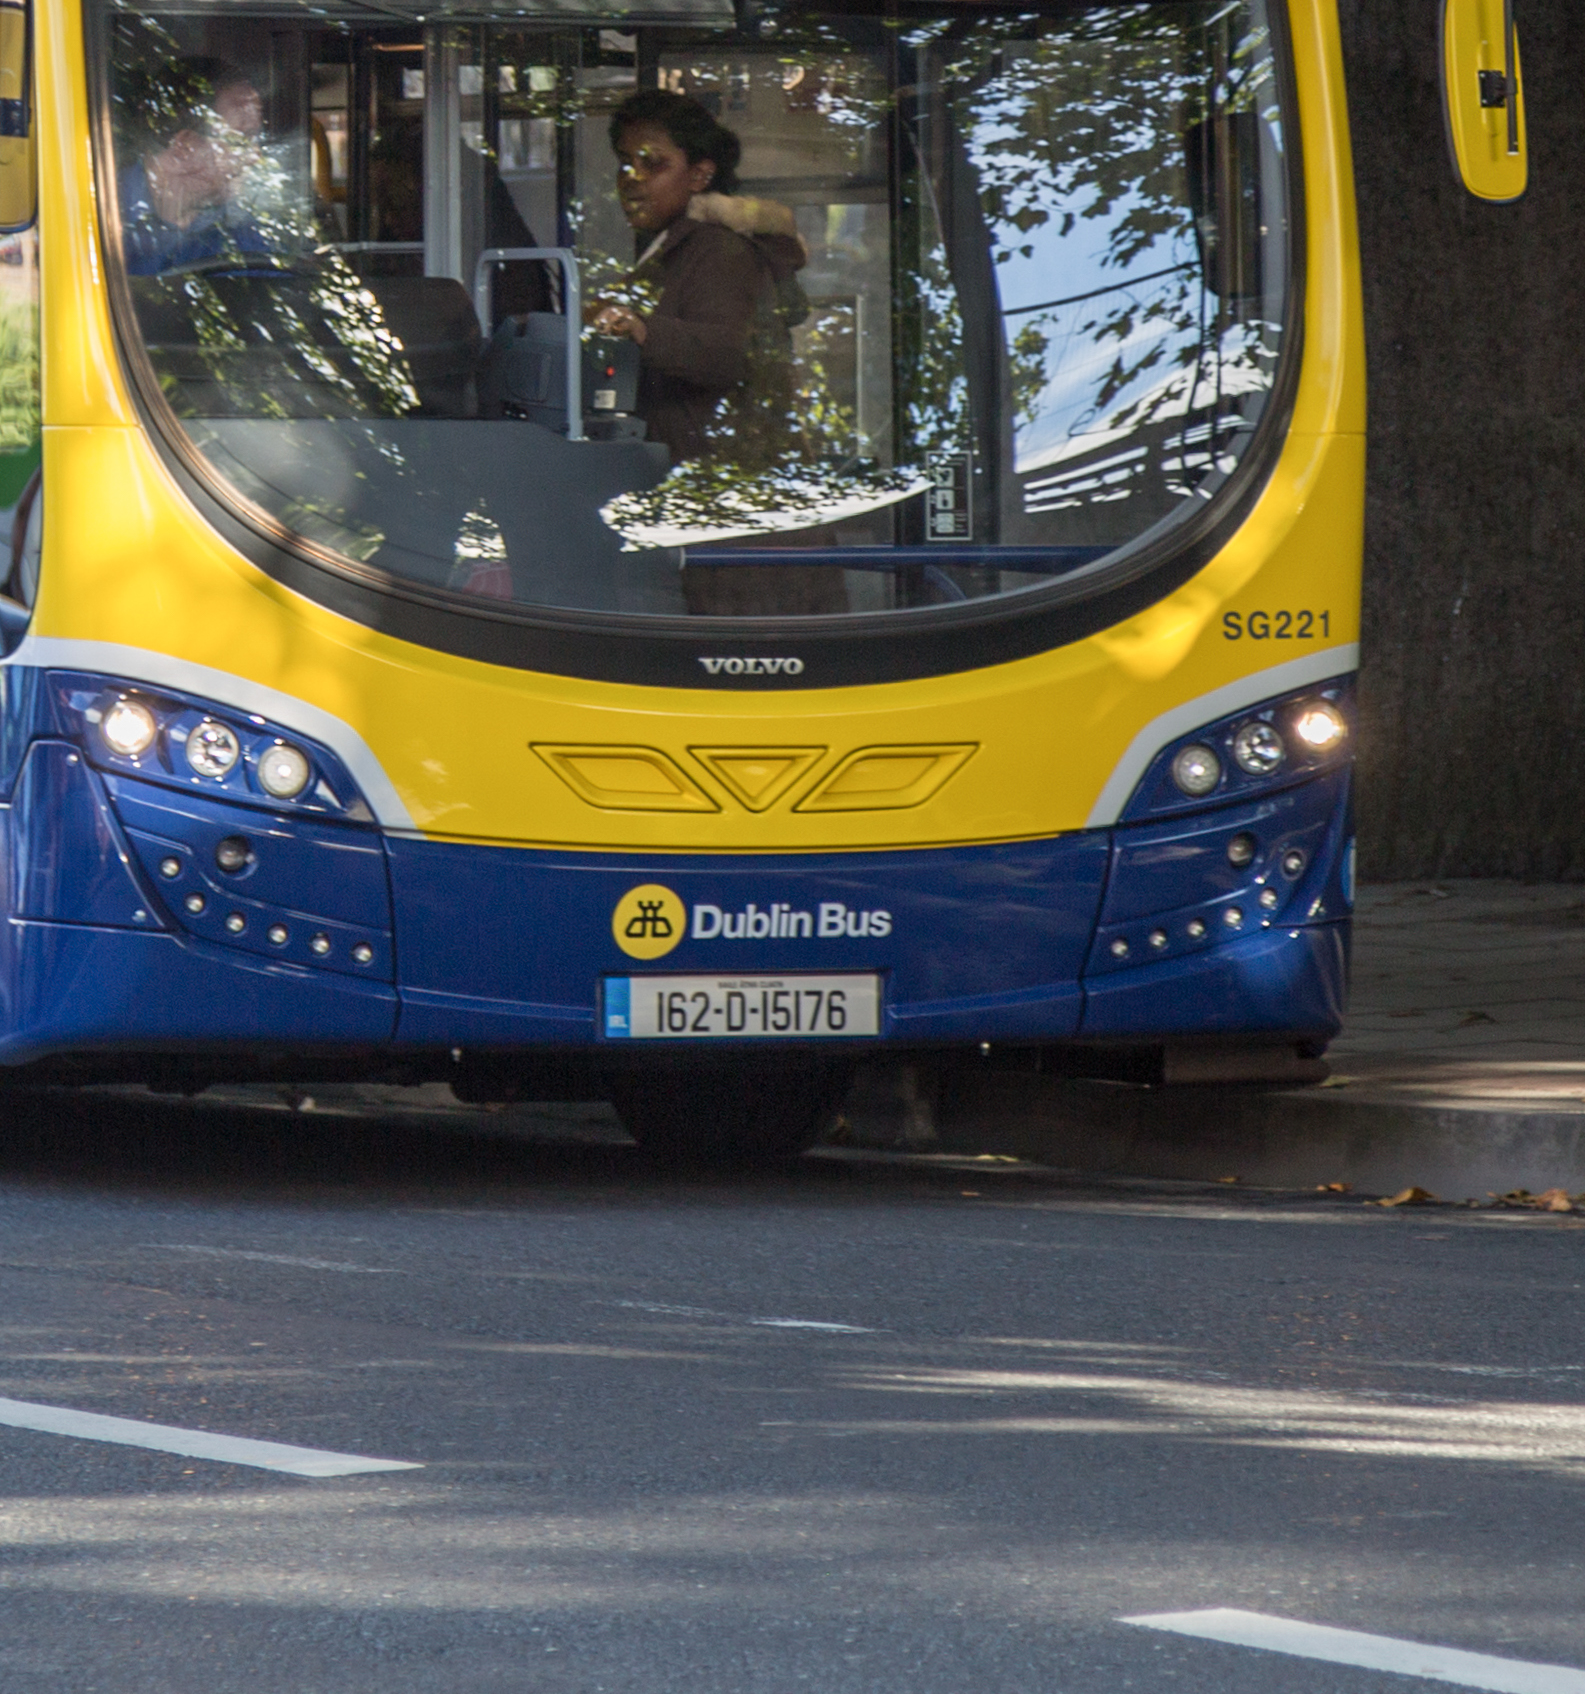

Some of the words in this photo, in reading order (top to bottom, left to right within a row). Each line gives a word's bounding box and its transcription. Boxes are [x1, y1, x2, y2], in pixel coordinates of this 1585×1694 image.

[1222, 610, 1329, 640] SG221
[698, 657, 805, 675] VOLVO
[692, 904, 813, 939] Dublin
[817, 903, 892, 938] Bus
[657, 990, 847, 1033] 162-D-15176
